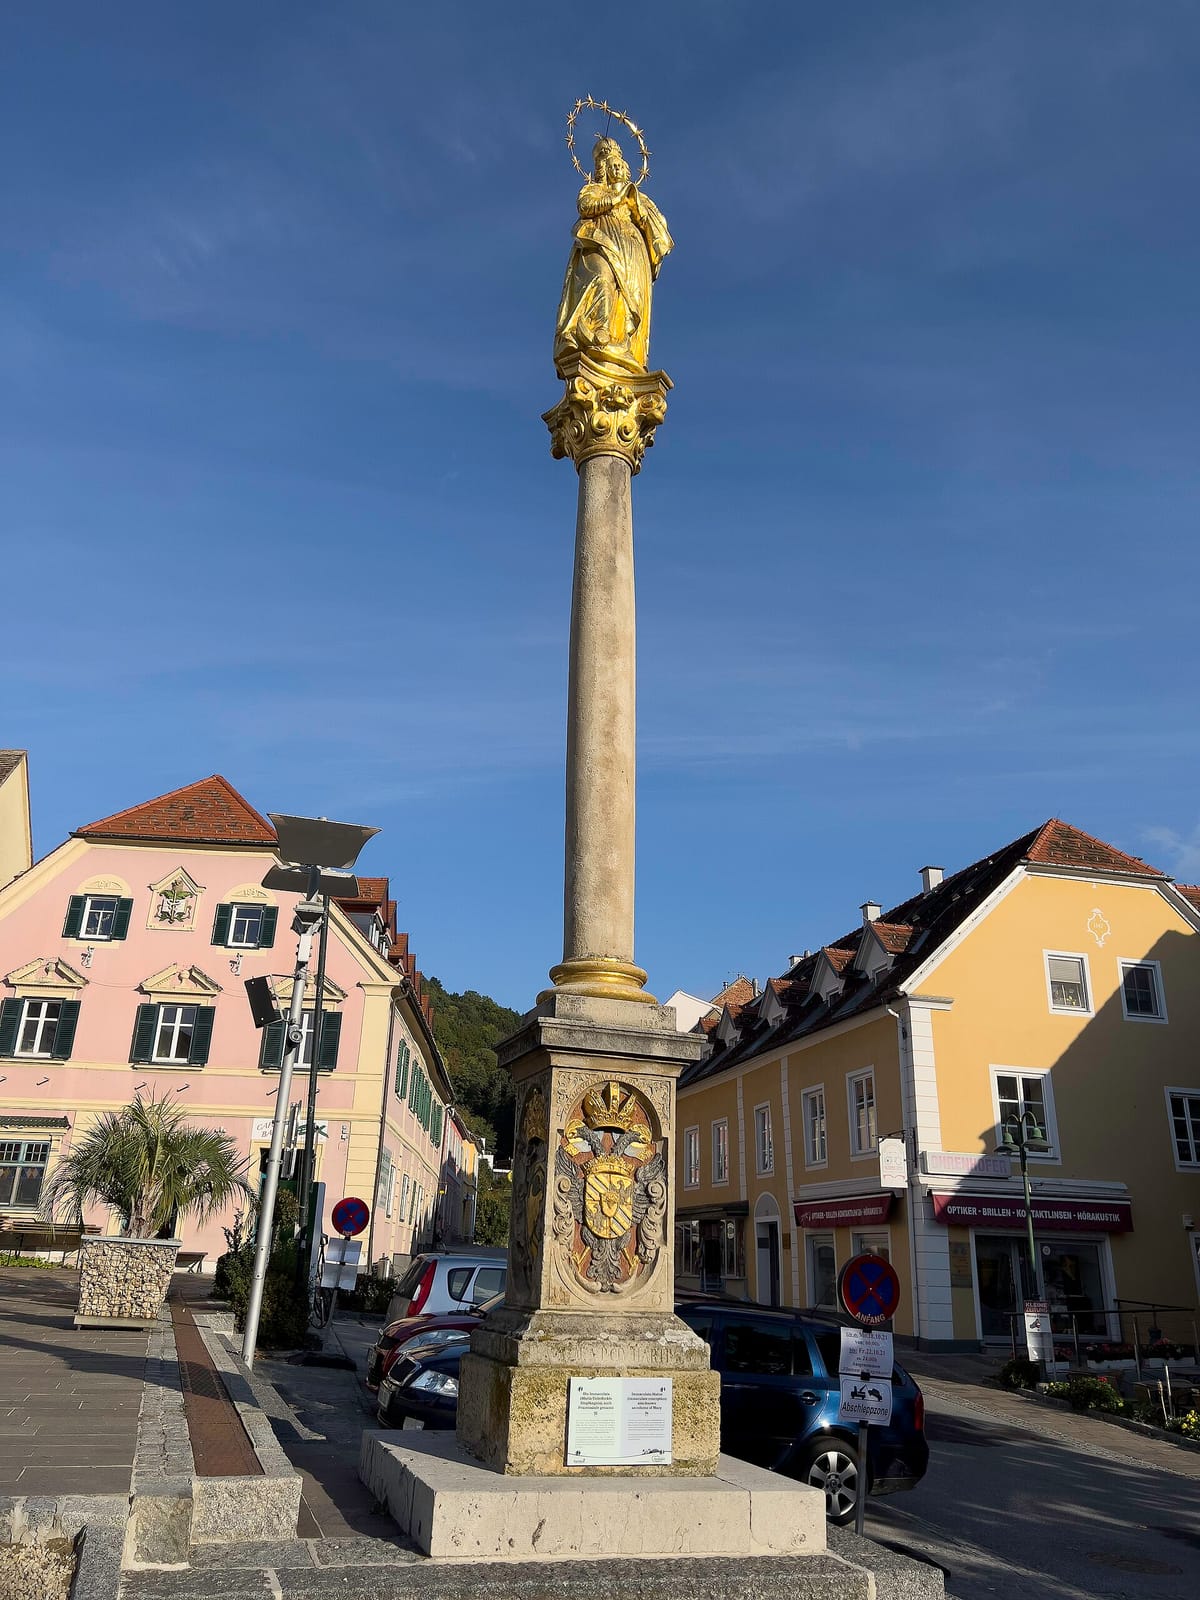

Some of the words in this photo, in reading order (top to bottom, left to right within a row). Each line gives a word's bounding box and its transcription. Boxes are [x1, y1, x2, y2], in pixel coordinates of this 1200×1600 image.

[947, 1205, 977, 1216] OPTIKER
[982, 1207, 1011, 1217] BRILLEN
[1016, 1208, 1072, 1220] KOTAKTLINSEN
[1077, 1211, 1120, 1222] HÖRAKUSTIK
[856, 1312, 886, 1323] ANFANG
[842, 1401, 889, 1416] Abschleppzone
